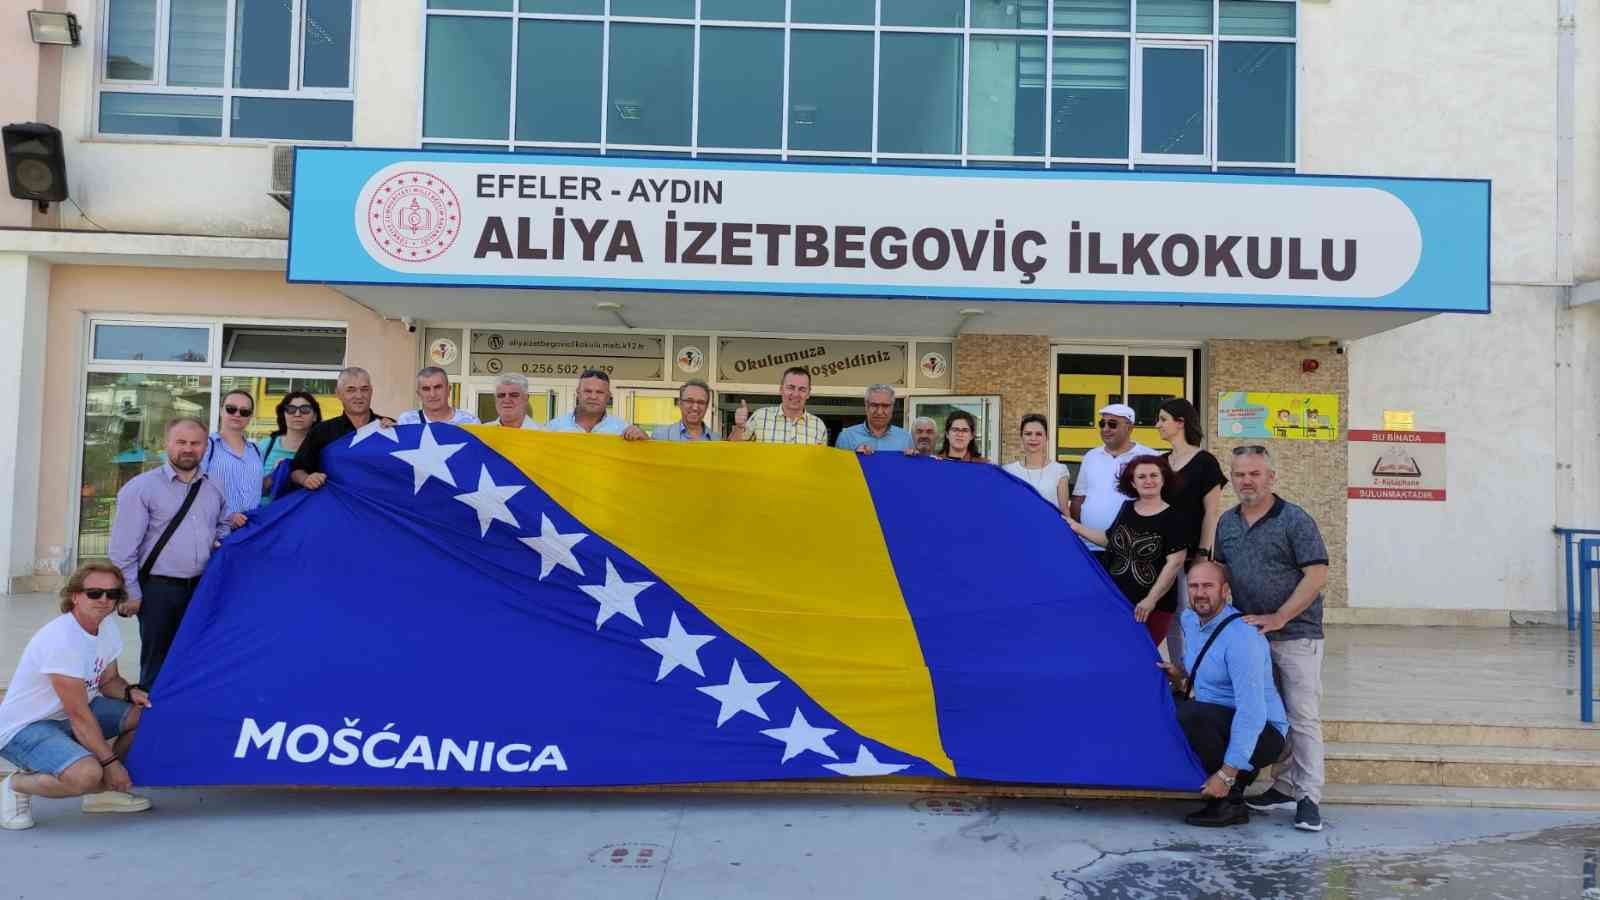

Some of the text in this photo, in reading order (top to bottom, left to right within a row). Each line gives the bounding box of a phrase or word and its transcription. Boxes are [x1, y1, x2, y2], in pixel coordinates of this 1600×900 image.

[476, 173, 602, 201] EFELER
[628, 179, 723, 204] AYDIN
[473, 206, 644, 263] ALİYA
[664, 210, 1048, 284] İZETBEGOVİÇ
[1068, 220, 1358, 282] İLKOKULU
[521, 363, 554, 374] 0.256
[557, 363, 578, 375] 502
[734, 346, 826, 373] Okulumuza
[1388, 431, 1422, 442] BİNADA
[234, 717, 568, 773] MOŠĆANICA
